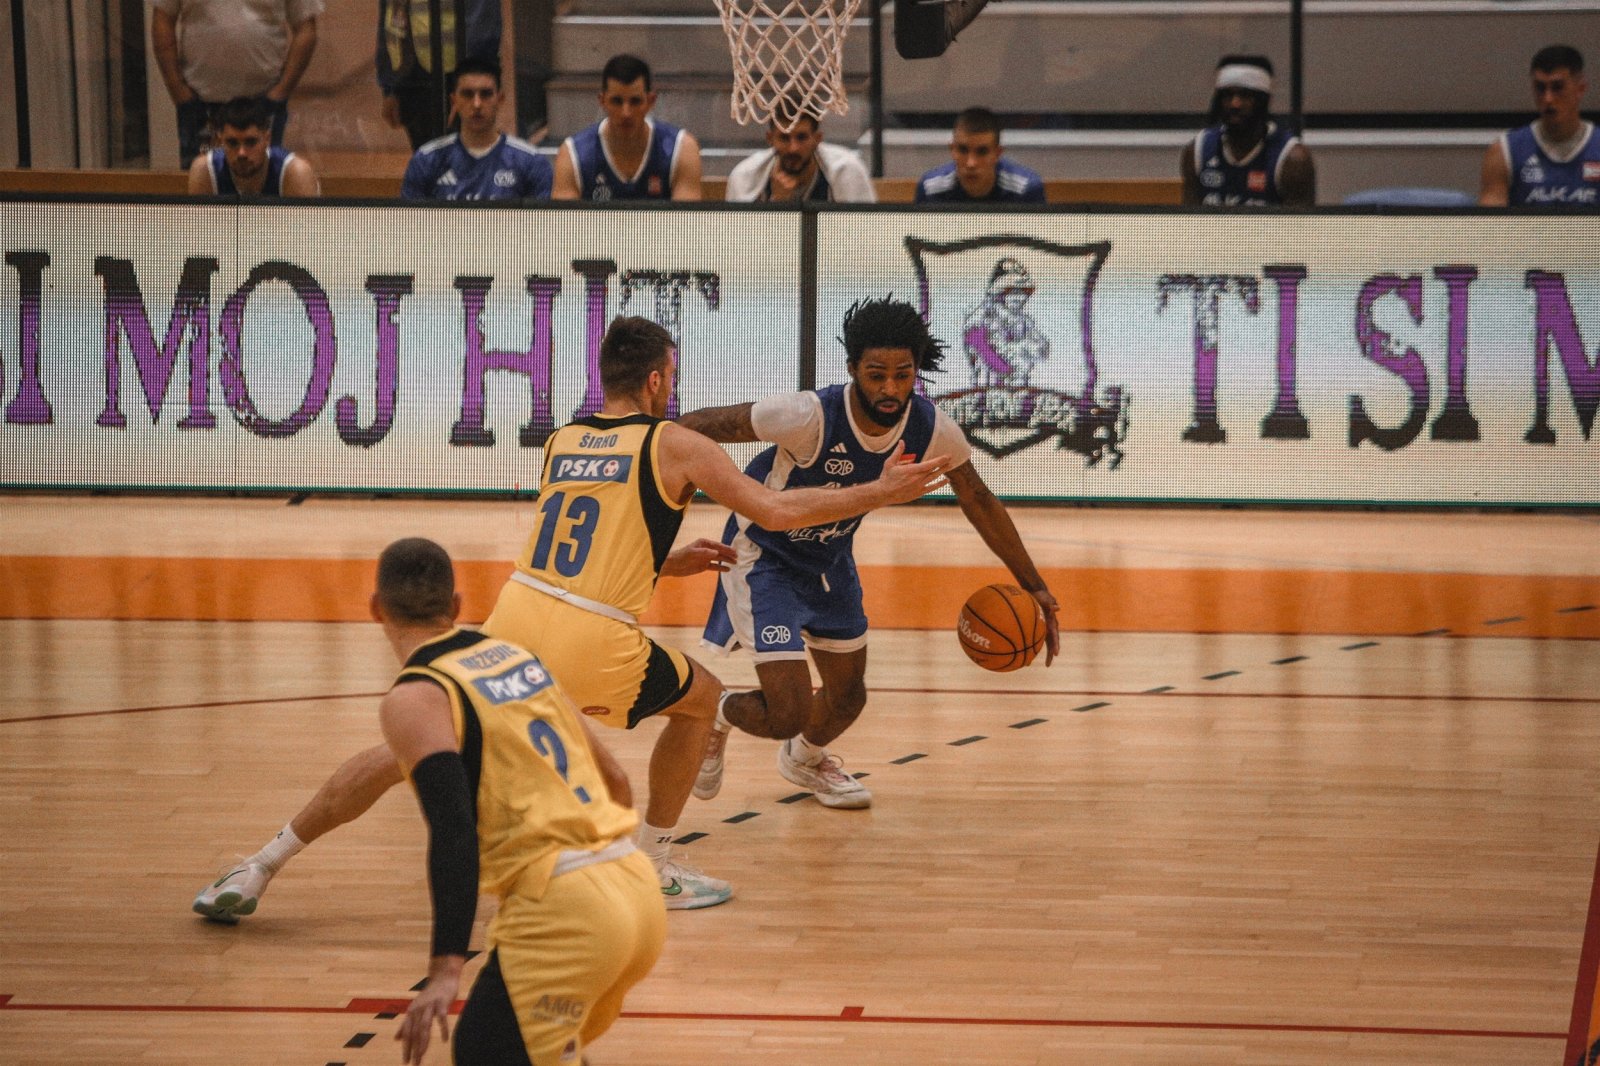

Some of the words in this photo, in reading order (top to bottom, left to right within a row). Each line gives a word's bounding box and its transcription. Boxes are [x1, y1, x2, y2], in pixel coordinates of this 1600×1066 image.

[0, 251, 54, 425] I
[94, 255, 416, 449] MOJ
[449, 258, 721, 448] HIT
[1156, 264, 1311, 445] TI
[1347, 264, 1482, 451] SI
[532, 490, 600, 578] 13
[556, 458, 606, 479] PSK
